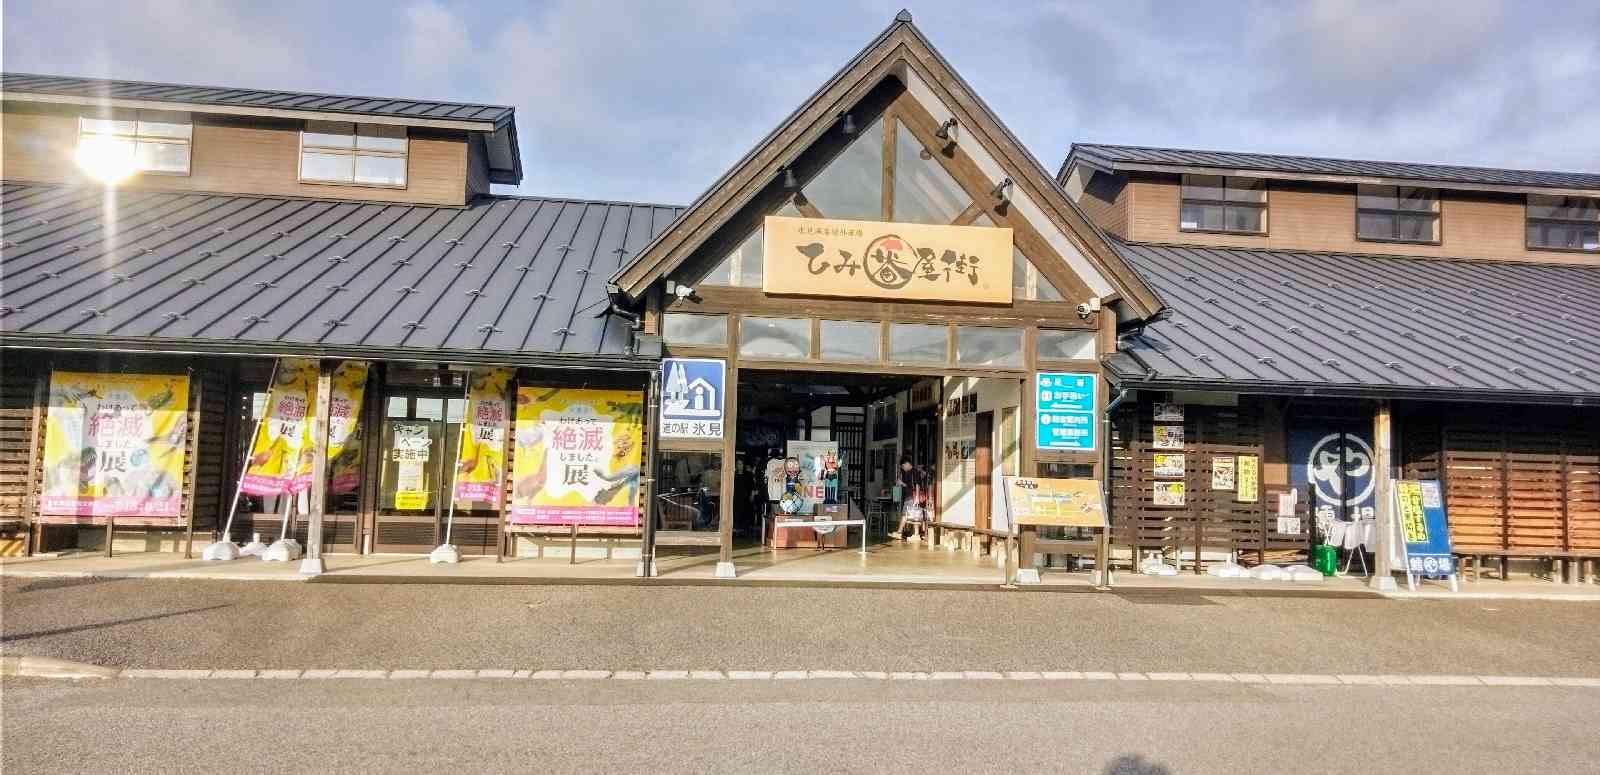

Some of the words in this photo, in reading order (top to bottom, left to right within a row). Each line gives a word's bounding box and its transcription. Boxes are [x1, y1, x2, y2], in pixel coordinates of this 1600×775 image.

[795, 234, 981, 290] ひみ番屋街
[88, 412, 145, 438] 絶滅
[560, 415, 600, 425] わけあって
[663, 421, 688, 434] 道の駅
[692, 421, 722, 437] 氷見
[480, 427, 494, 440] 展
[552, 425, 604, 451] 絶滅
[99, 449, 128, 473] 展
[393, 447, 428, 460] 実施中
[562, 463, 591, 486] 展
